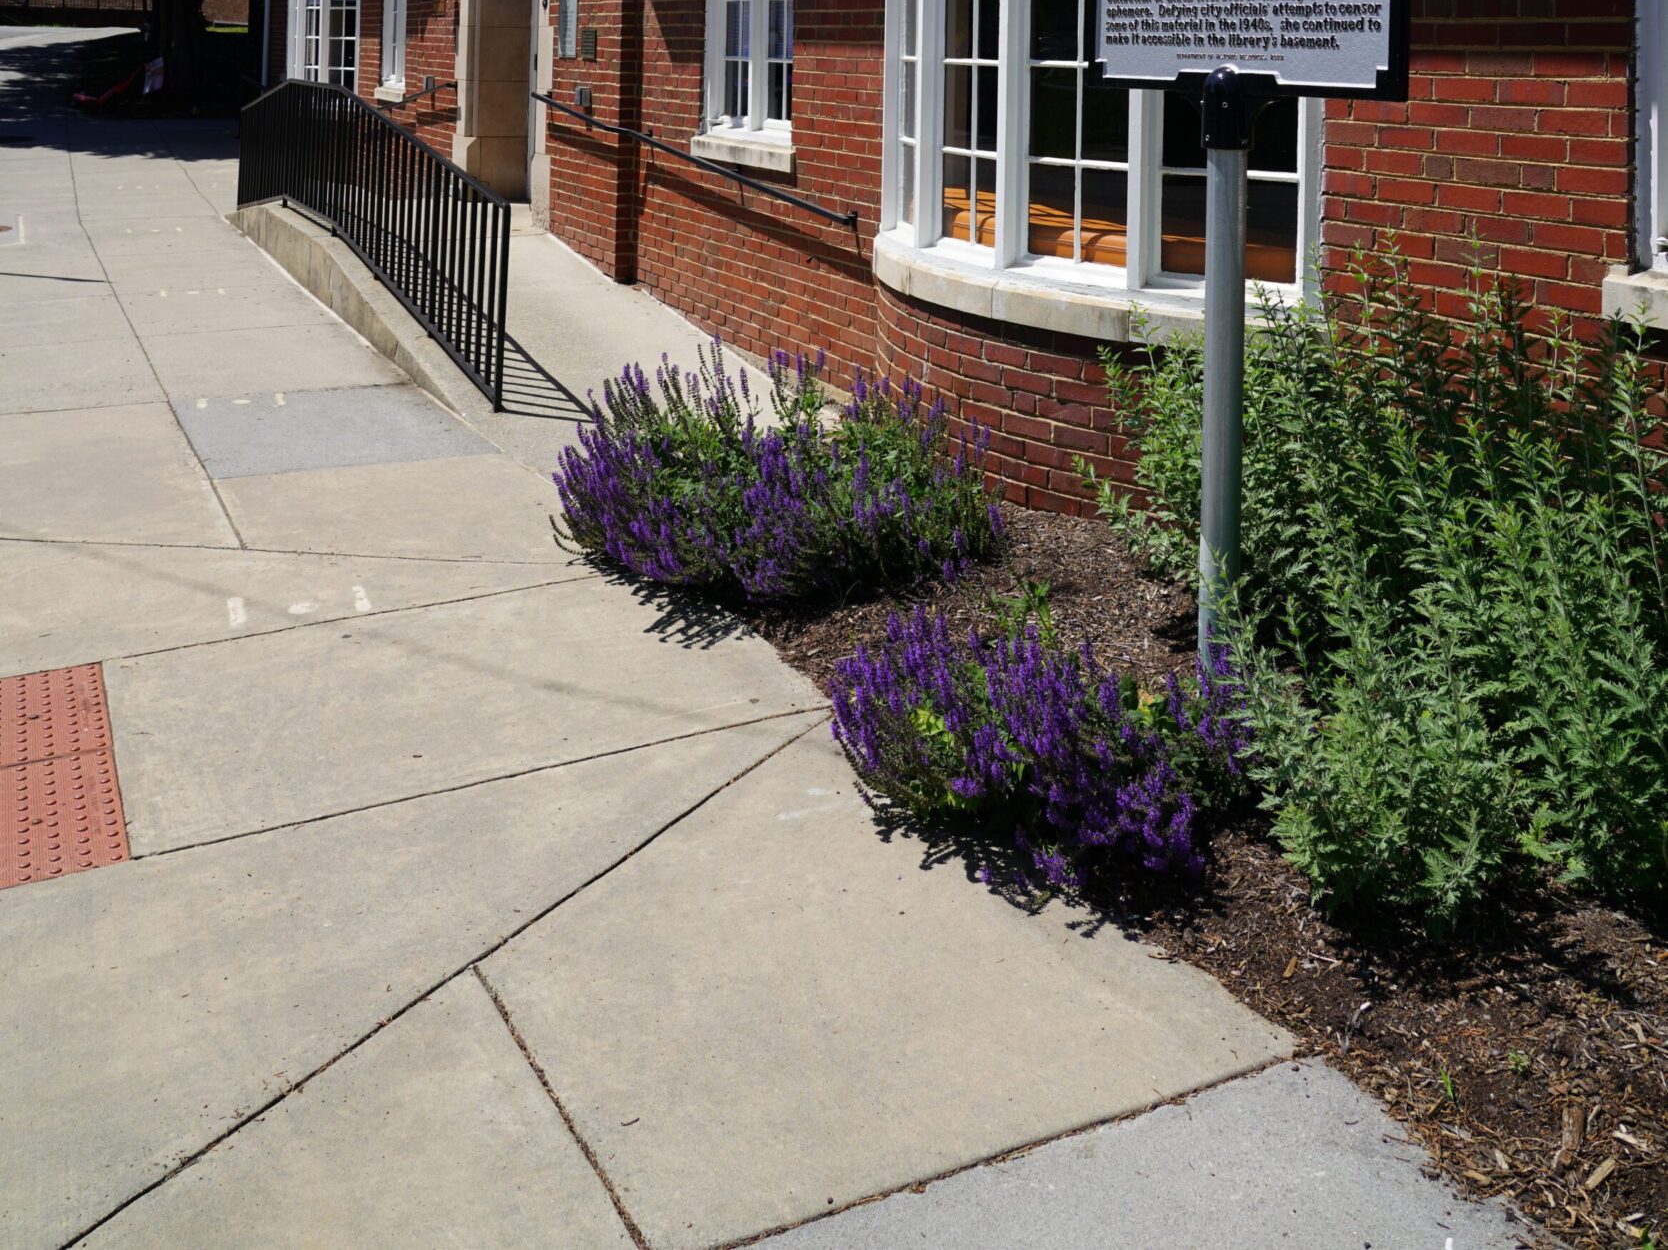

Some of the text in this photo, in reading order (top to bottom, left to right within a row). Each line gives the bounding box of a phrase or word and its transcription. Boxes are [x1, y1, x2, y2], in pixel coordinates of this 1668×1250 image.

[1159, 4, 1198, 18] Defying
[1201, 4, 1221, 19] city
[1272, 2, 1322, 17] attempts
[1325, 2, 1336, 15] to
[1339, 2, 1382, 16] censor
[1106, 21, 1127, 31] some
[1129, 19, 1138, 31] of
[1141, 19, 1159, 31] this
[1161, 19, 1202, 31] material
[1205, 19, 1215, 31] in
[1219, 18, 1236, 31] the
[1280, 18, 1300, 31] she
[1302, 17, 1365, 31] continued
[1368, 18, 1382, 31] to
[1106, 34, 1129, 45] make
[1132, 33, 1139, 45] it
[1141, 33, 1191, 46] accessible
[1194, 33, 1204, 46] in
[1207, 34, 1225, 47] the
